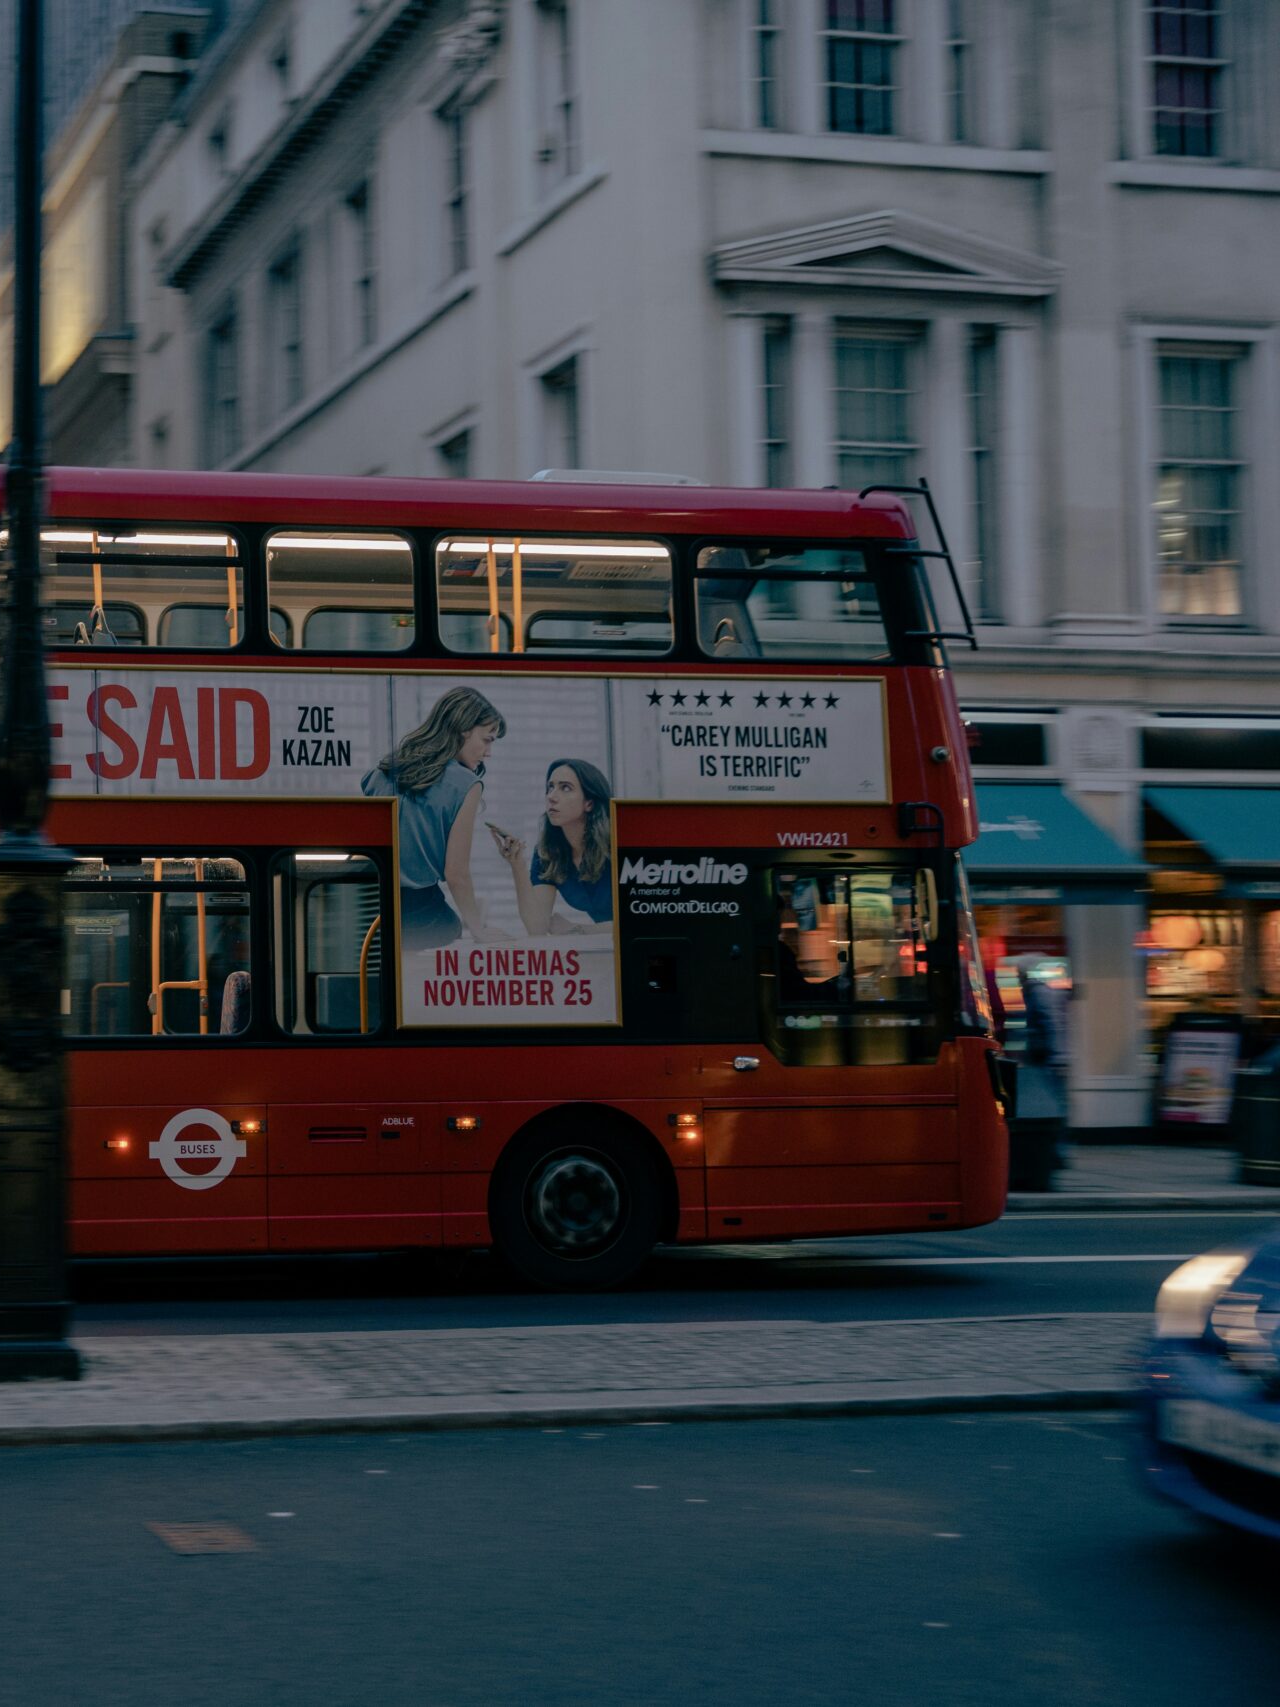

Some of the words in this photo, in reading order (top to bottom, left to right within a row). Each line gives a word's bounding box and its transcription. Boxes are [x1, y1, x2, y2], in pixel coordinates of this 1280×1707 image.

[86, 684, 271, 780] SAID
[297, 706, 335, 733] ZOE
[661, 725, 732, 748] “CAREY
[735, 726, 828, 749] MULLIGAN
[282, 739, 351, 766] KAZAN
[699, 755, 717, 776] IS
[720, 755, 811, 778] TERRIFIC”
[777, 833, 848, 846] VWH2421
[620, 857, 748, 885] Metroline
[630, 887, 638, 896] A
[639, 887, 669, 896] member
[671, 887, 680, 896] of
[436, 950, 458, 975] IN
[469, 949, 580, 976] CINEMAS
[424, 979, 554, 1006] NOVEMBER
[564, 979, 592, 1005] 25
[382, 1117, 413, 1126] ADBLUE
[180, 1143, 215, 1155] BUSES
